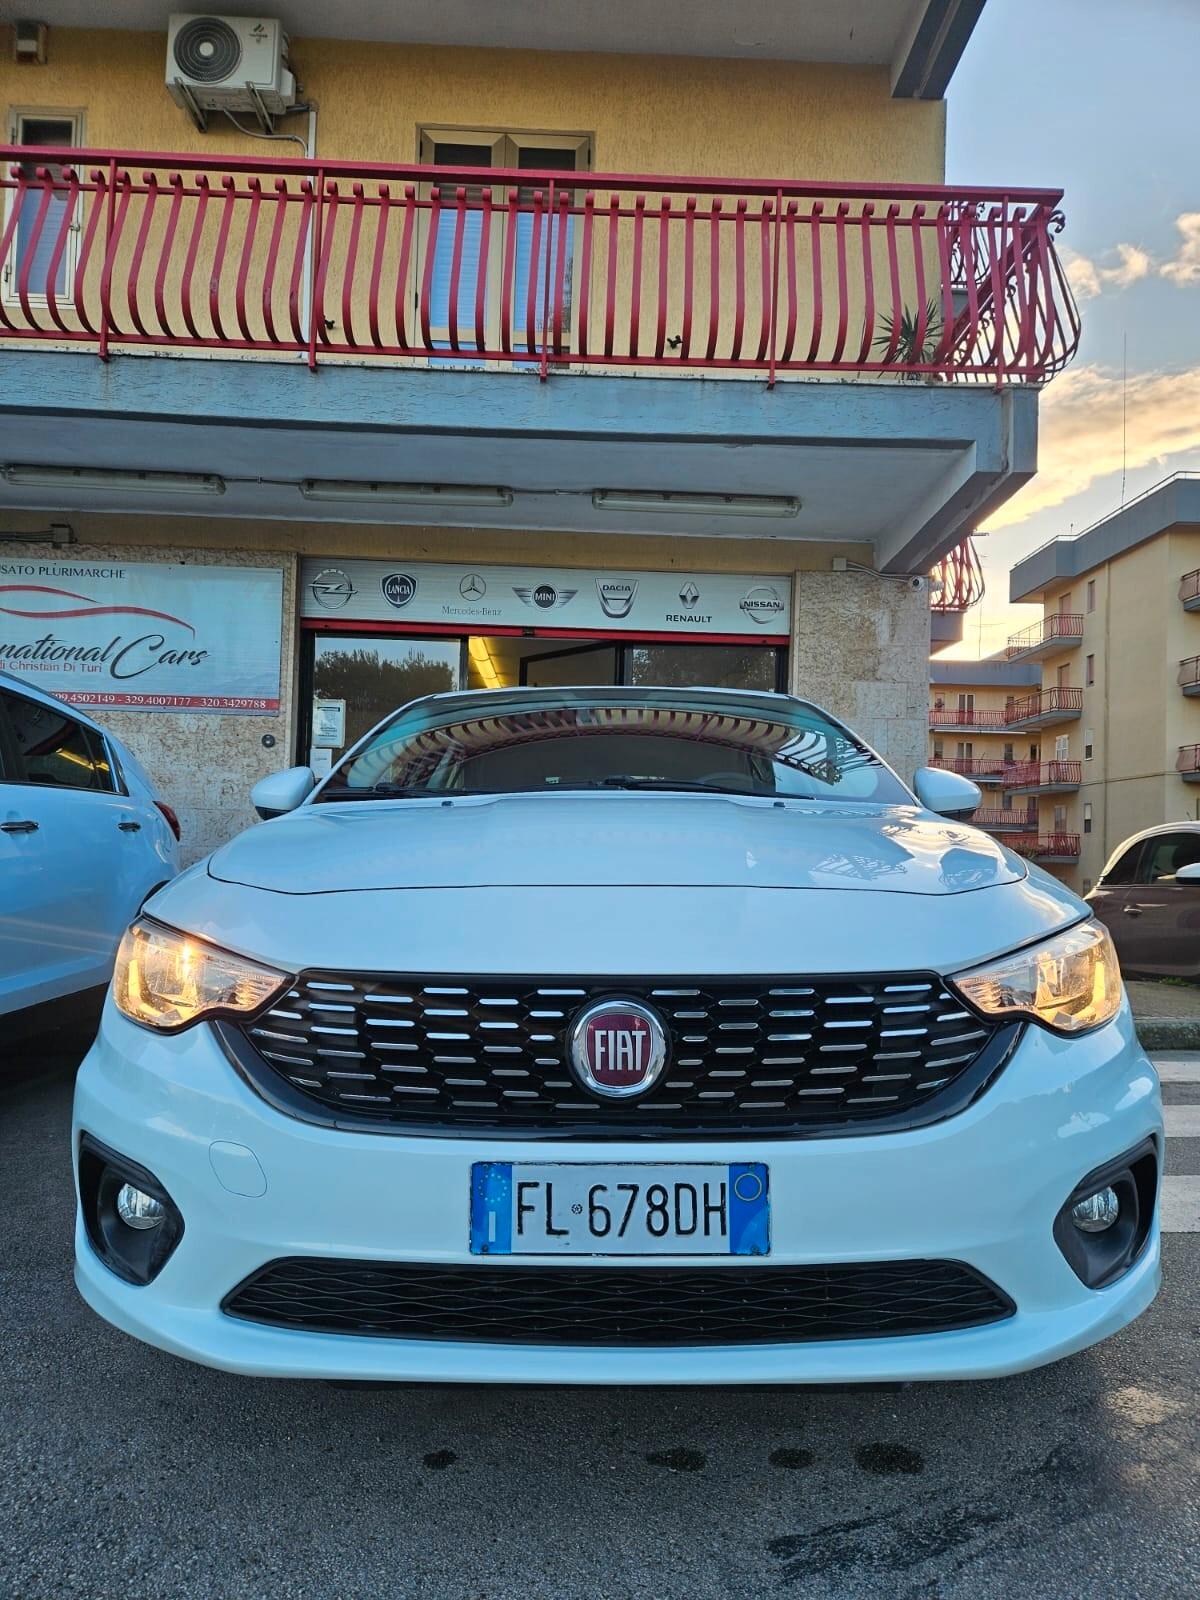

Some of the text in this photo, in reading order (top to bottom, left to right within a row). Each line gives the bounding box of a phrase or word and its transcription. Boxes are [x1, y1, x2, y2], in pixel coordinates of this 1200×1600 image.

[0, 564, 127, 579] SATO PLURIMARCHE
[388, 585, 411, 595] LANCIA
[602, 583, 631, 592] DACIA
[535, 592, 556, 602] MINI
[743, 600, 781, 609] NISSAN
[442, 605, 502, 617] Mercedes-Benz
[666, 614, 713, 624] RENAULT
[110, 634, 211, 680] Cars
[9, 661, 60, 672] Christian
[63, 662, 76, 673] Di
[80, 663, 103, 673] Turi
[125, 695, 191, 706] 329.4007177
[200, 698, 267, 709] 320.3429788
[594, 1029, 647, 1072] FIAT
